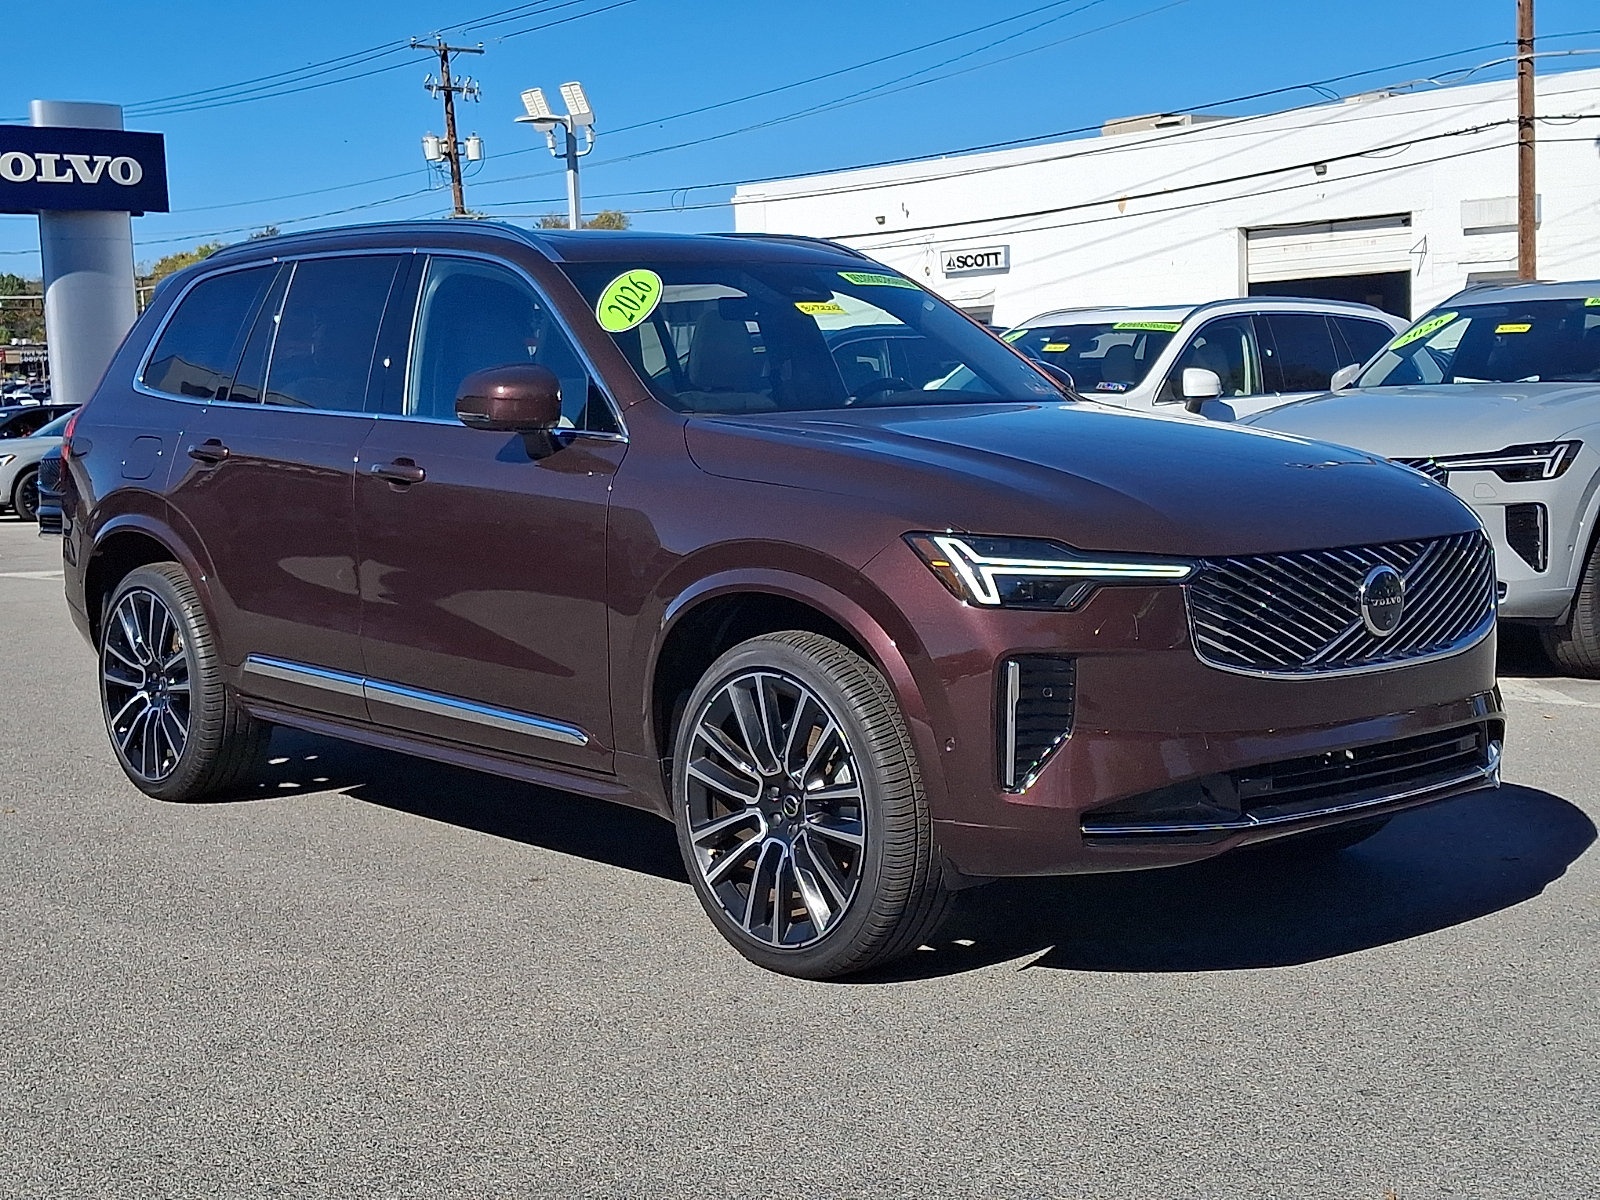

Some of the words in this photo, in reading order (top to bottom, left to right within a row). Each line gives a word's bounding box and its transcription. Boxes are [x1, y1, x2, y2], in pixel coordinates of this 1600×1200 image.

[0, 151, 143, 186] OLVO
[956, 252, 1002, 269] SCOTT
[607, 275, 653, 323] 2026
